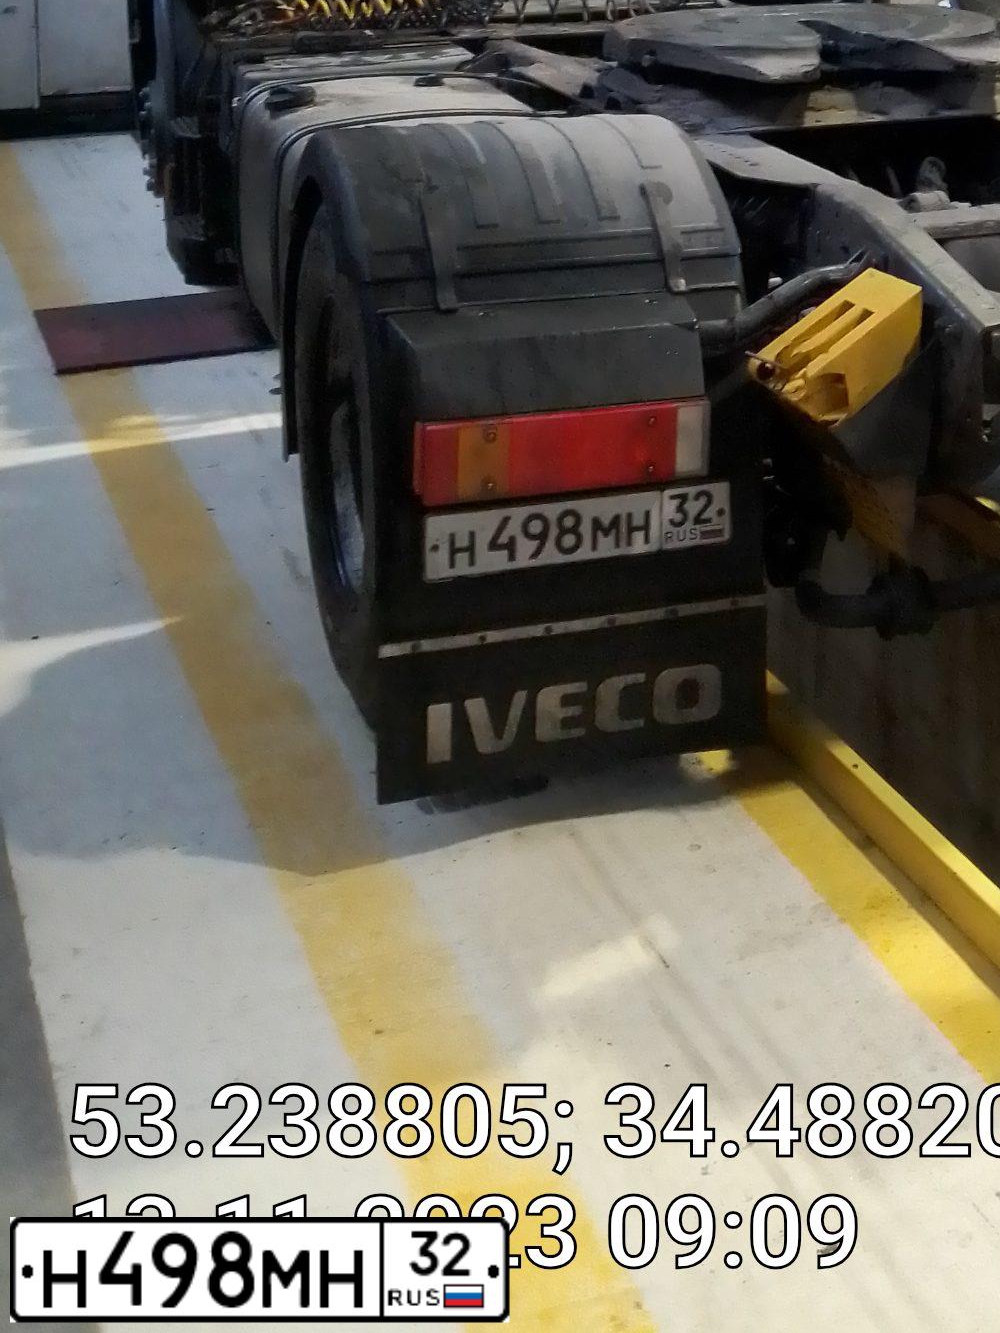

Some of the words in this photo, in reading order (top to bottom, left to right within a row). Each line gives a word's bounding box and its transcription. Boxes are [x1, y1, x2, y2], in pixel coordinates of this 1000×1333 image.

[668, 489, 714, 528] 32
[663, 528, 698, 544] RUS
[426, 663, 721, 765] IVECO
